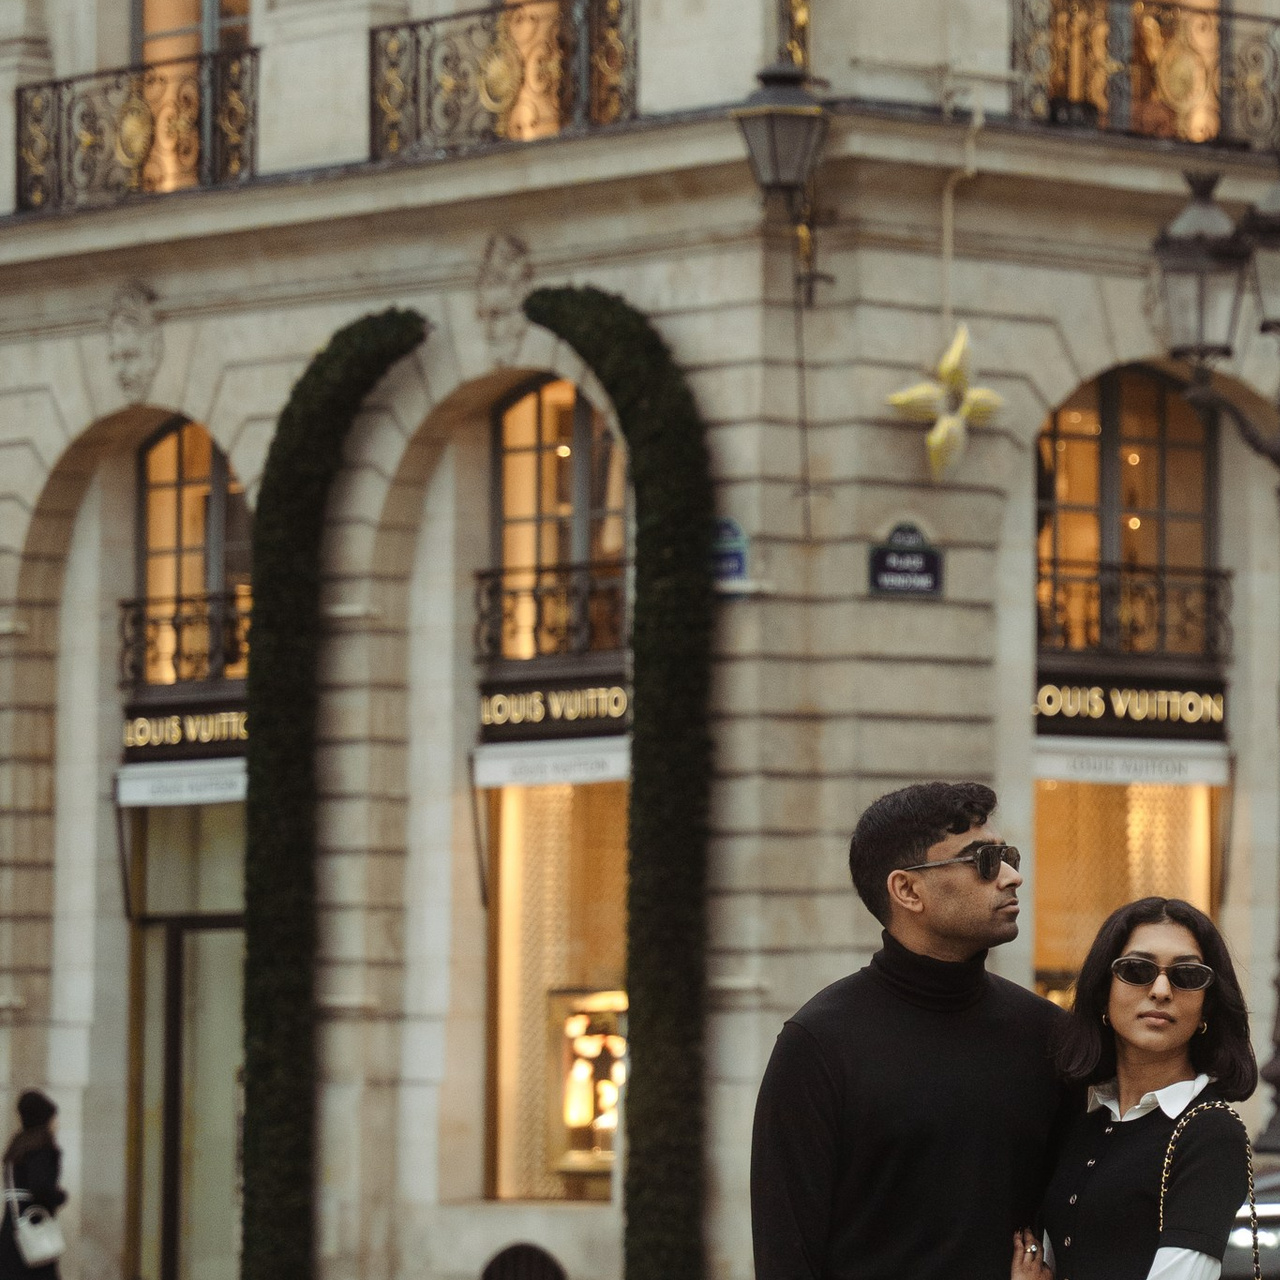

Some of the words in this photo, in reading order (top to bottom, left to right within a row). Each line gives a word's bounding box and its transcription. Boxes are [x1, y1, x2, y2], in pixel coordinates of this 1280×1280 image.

[481, 691, 545, 725] LOUIS
[549, 686, 628, 721] VUITTO
[1031, 684, 1105, 719] OUIS
[1110, 687, 1224, 723] VUITTON
[124, 715, 182, 747] LOUIS
